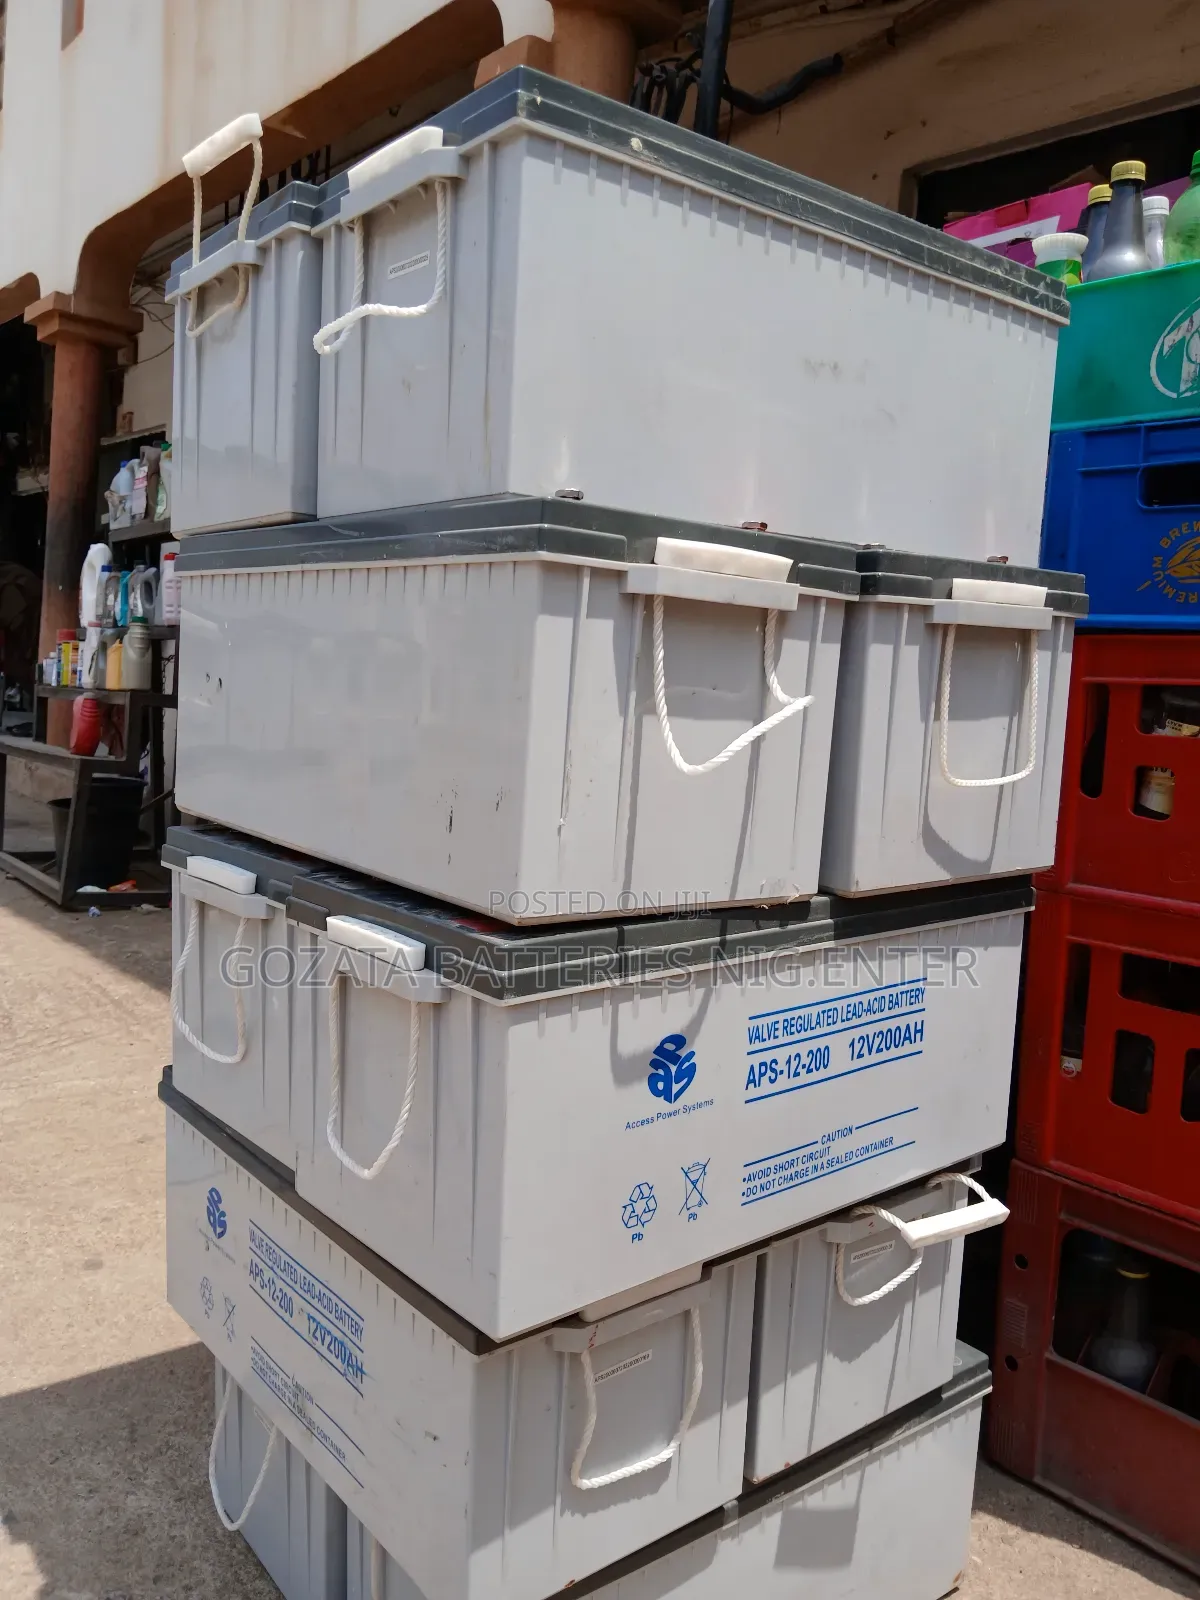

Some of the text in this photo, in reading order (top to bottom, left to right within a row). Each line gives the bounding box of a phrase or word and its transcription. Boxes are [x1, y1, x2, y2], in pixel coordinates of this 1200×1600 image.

[748, 987, 926, 1045] VALVE REGULATED LEAD-ACID BATTERY
[745, 1020, 925, 1090] APS-12-200 12V200AH
[625, 1098, 714, 1131] Access Power Systems
[821, 1125, 854, 1145] CAUTION
[759, 1179, 776, 1193] NOT
[777, 1166, 810, 1187] CHARGE
[811, 1164, 819, 1175] IN
[819, 1162, 825, 1172] A
[826, 1151, 854, 1169] SEALED
[855, 1136, 894, 1158] CONTAINER
[773, 1156, 800, 1175] SHORT
[801, 1146, 831, 1165] CIRCUIT
[631, 1232, 644, 1244] Pb
[687, 1212, 698, 1222] Pb
[249, 1226, 264, 1255] VALVE
[264, 1243, 298, 1285] REGULATED
[300, 1272, 333, 1315] LEAD-ACID
[334, 1302, 364, 1343] BATTERY
[249, 1258, 364, 1385] APS-12-200 12V200AH
